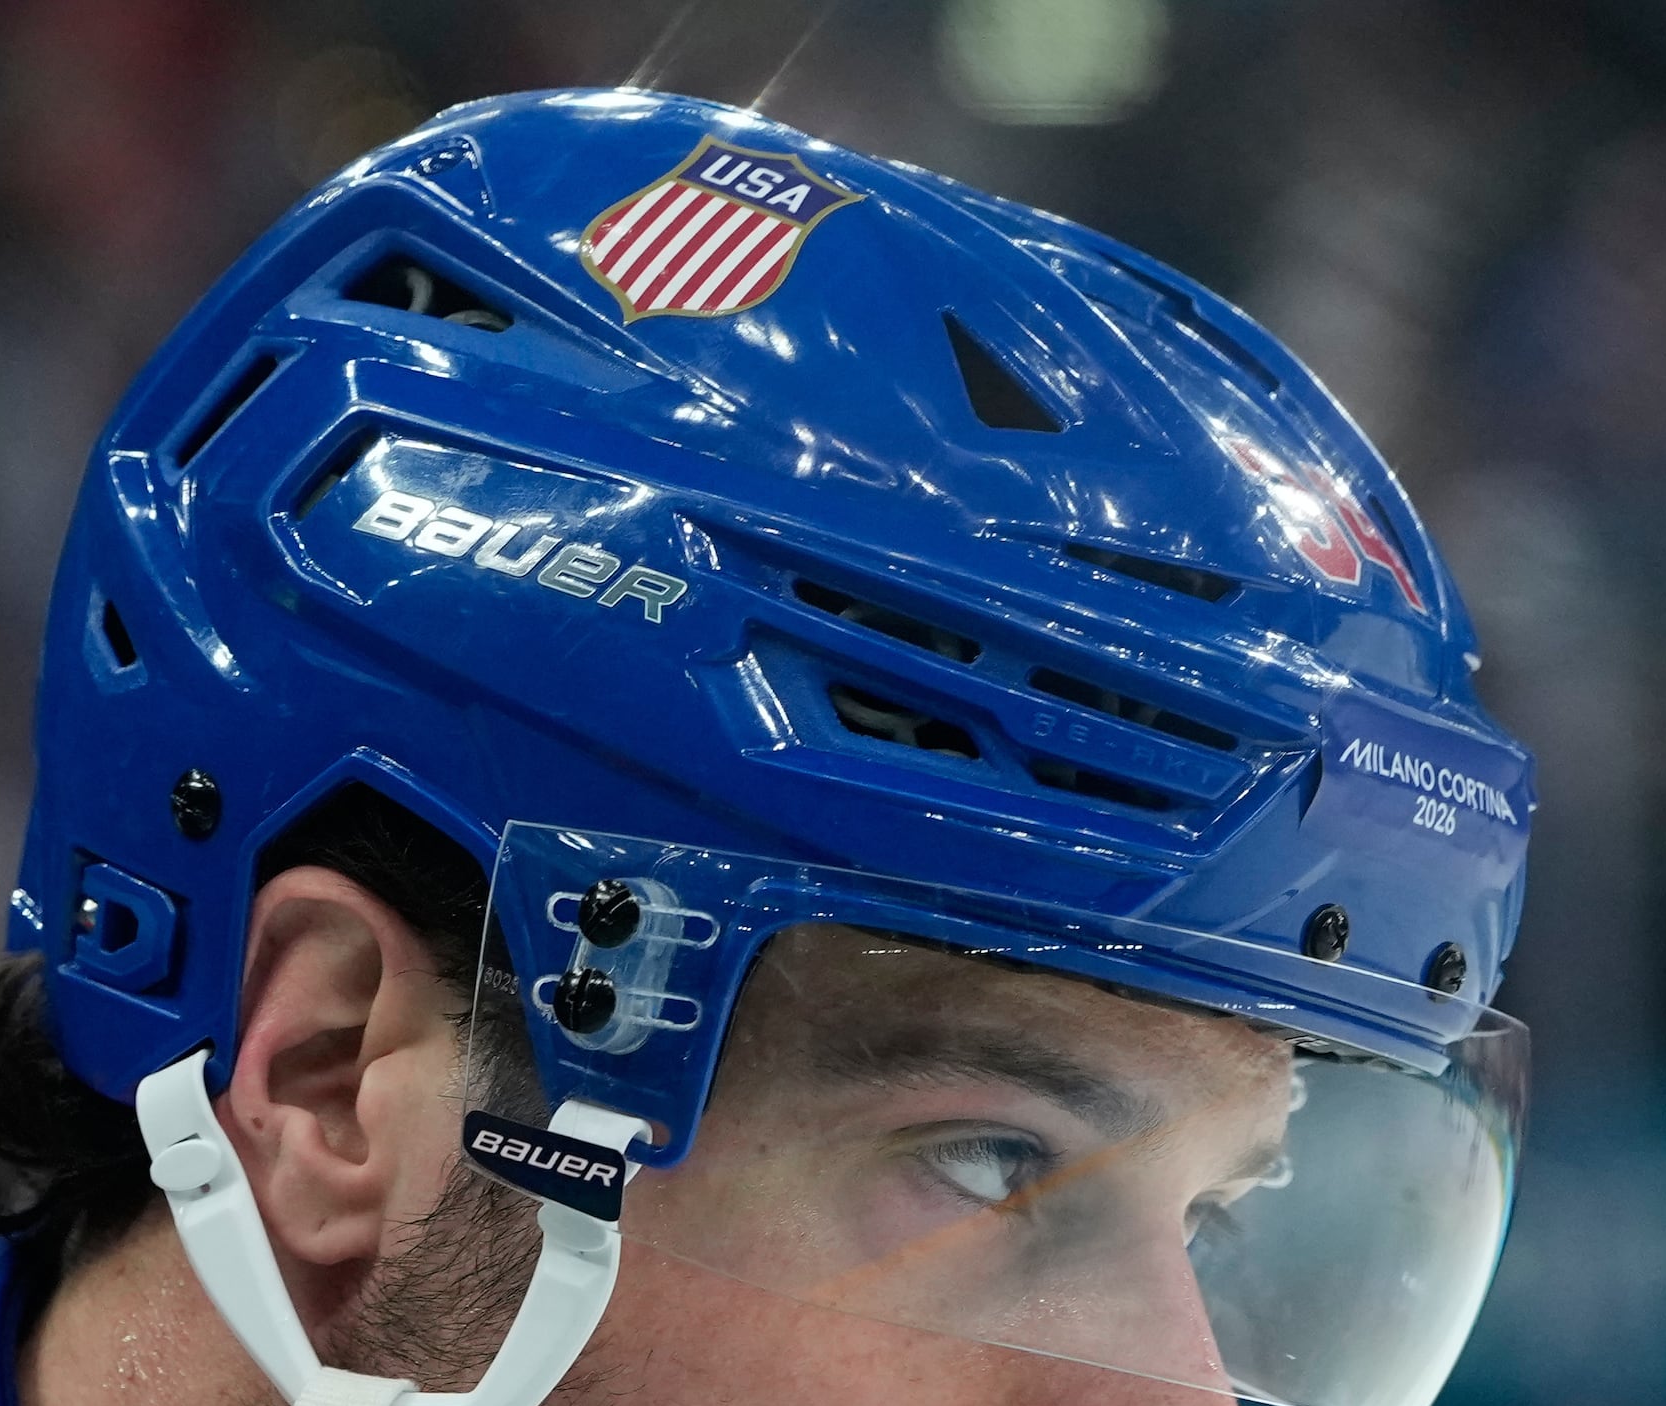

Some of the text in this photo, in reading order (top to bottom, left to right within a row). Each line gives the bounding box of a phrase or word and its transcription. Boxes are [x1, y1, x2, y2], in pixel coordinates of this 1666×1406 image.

[699, 154, 812, 214] USA
[1338, 737, 1518, 825] MILANO CORTINA
[1412, 794, 1457, 836] 2026
